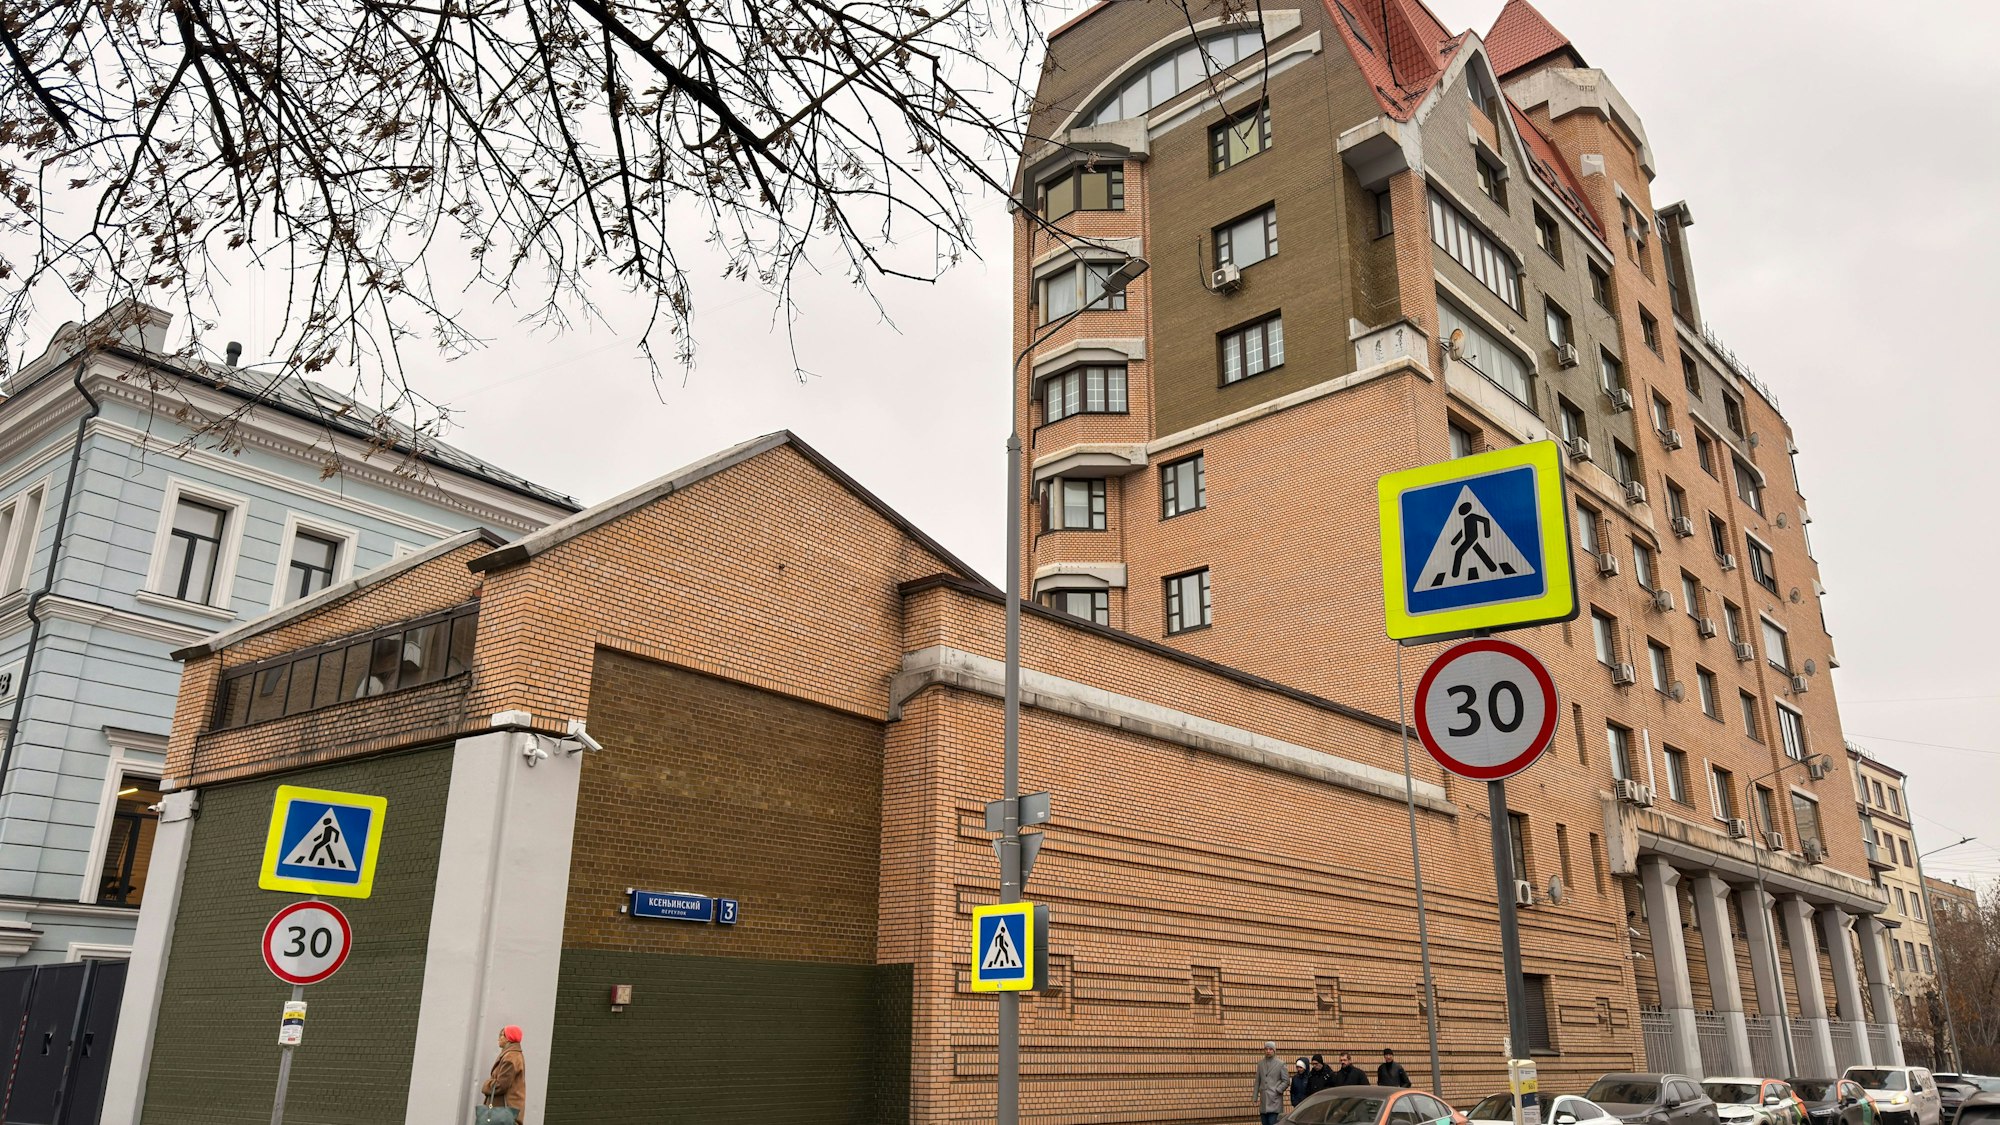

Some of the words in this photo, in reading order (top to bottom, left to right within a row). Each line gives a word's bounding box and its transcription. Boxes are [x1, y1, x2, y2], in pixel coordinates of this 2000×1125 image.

[1446, 680, 1524, 737] 30
[649, 897, 701, 911] КСЕНЬИНСКИЙ
[724, 902, 734, 920] 3
[283, 926, 333, 958] 30
